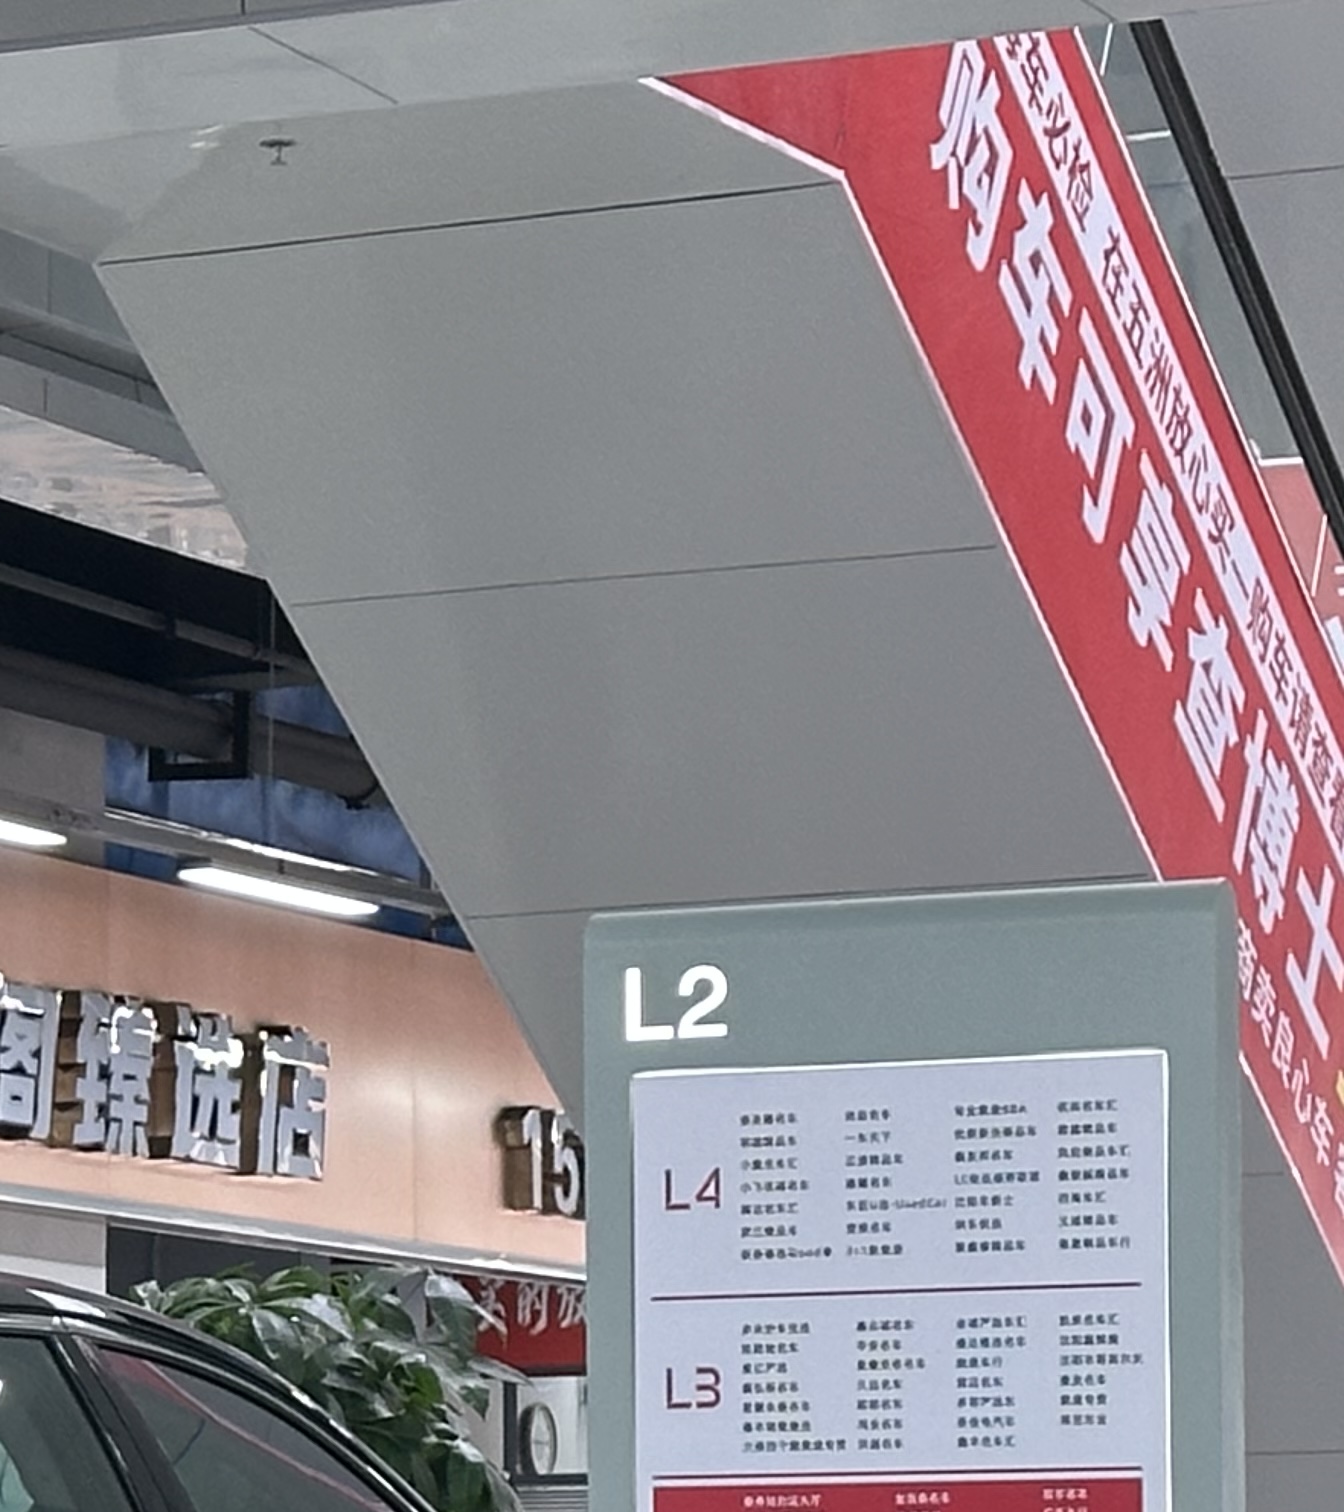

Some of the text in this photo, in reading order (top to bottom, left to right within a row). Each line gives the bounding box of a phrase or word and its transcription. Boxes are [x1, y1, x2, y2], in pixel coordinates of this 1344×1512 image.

[624, 964, 728, 1041] L2
[665, 1167, 720, 1210] L4
[666, 1367, 721, 1410] L3
